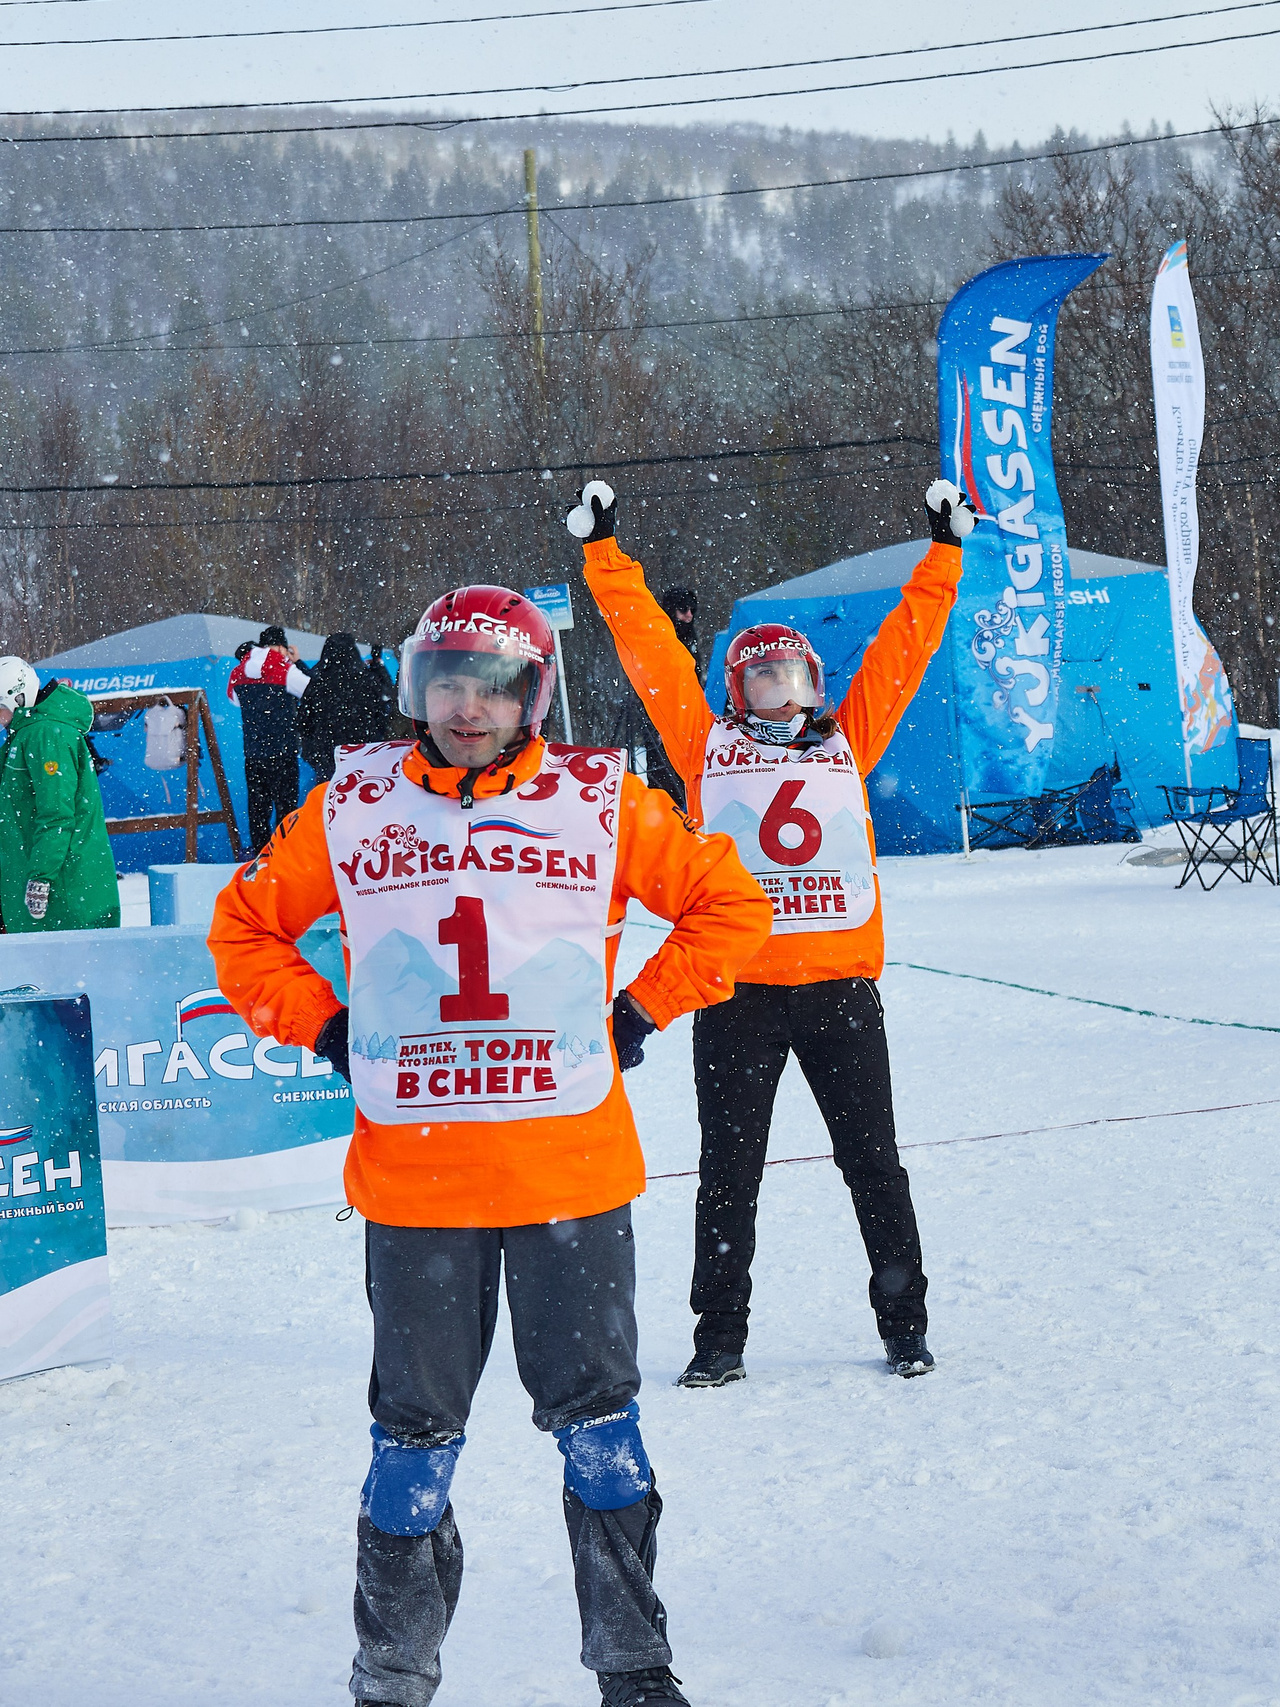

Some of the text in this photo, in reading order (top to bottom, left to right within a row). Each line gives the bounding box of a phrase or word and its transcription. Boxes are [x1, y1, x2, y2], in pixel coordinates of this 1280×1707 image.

[1031, 324, 1049, 434] СНЕЖНЫЙ БОЙ
[1051, 543, 1065, 597] REGION
[74, 674, 155, 691] HIGASHI
[758, 780, 822, 866] 6
[378, 881, 420, 894] MURMANSK
[421, 877, 450, 887] REGION
[535, 881, 597, 892] СНЕЖНЫЙ БОЙ
[788, 876, 844, 892] ТОЛК
[438, 895, 509, 1022] 1
[400, 1038, 554, 1061] ДЛЯ ТЕХ, ТОЛК
[398, 1055, 457, 1068] КТО ЗНАЕТ
[396, 1066, 557, 1099] В СНЕГЕ
[141, 1097, 212, 1111] ОБЛАСТЬ
[272, 1085, 349, 1103] СНЕЖНЫЙ
[57, 1199, 84, 1213] БОЙ
[583, 1410, 630, 1429] DEMIX
